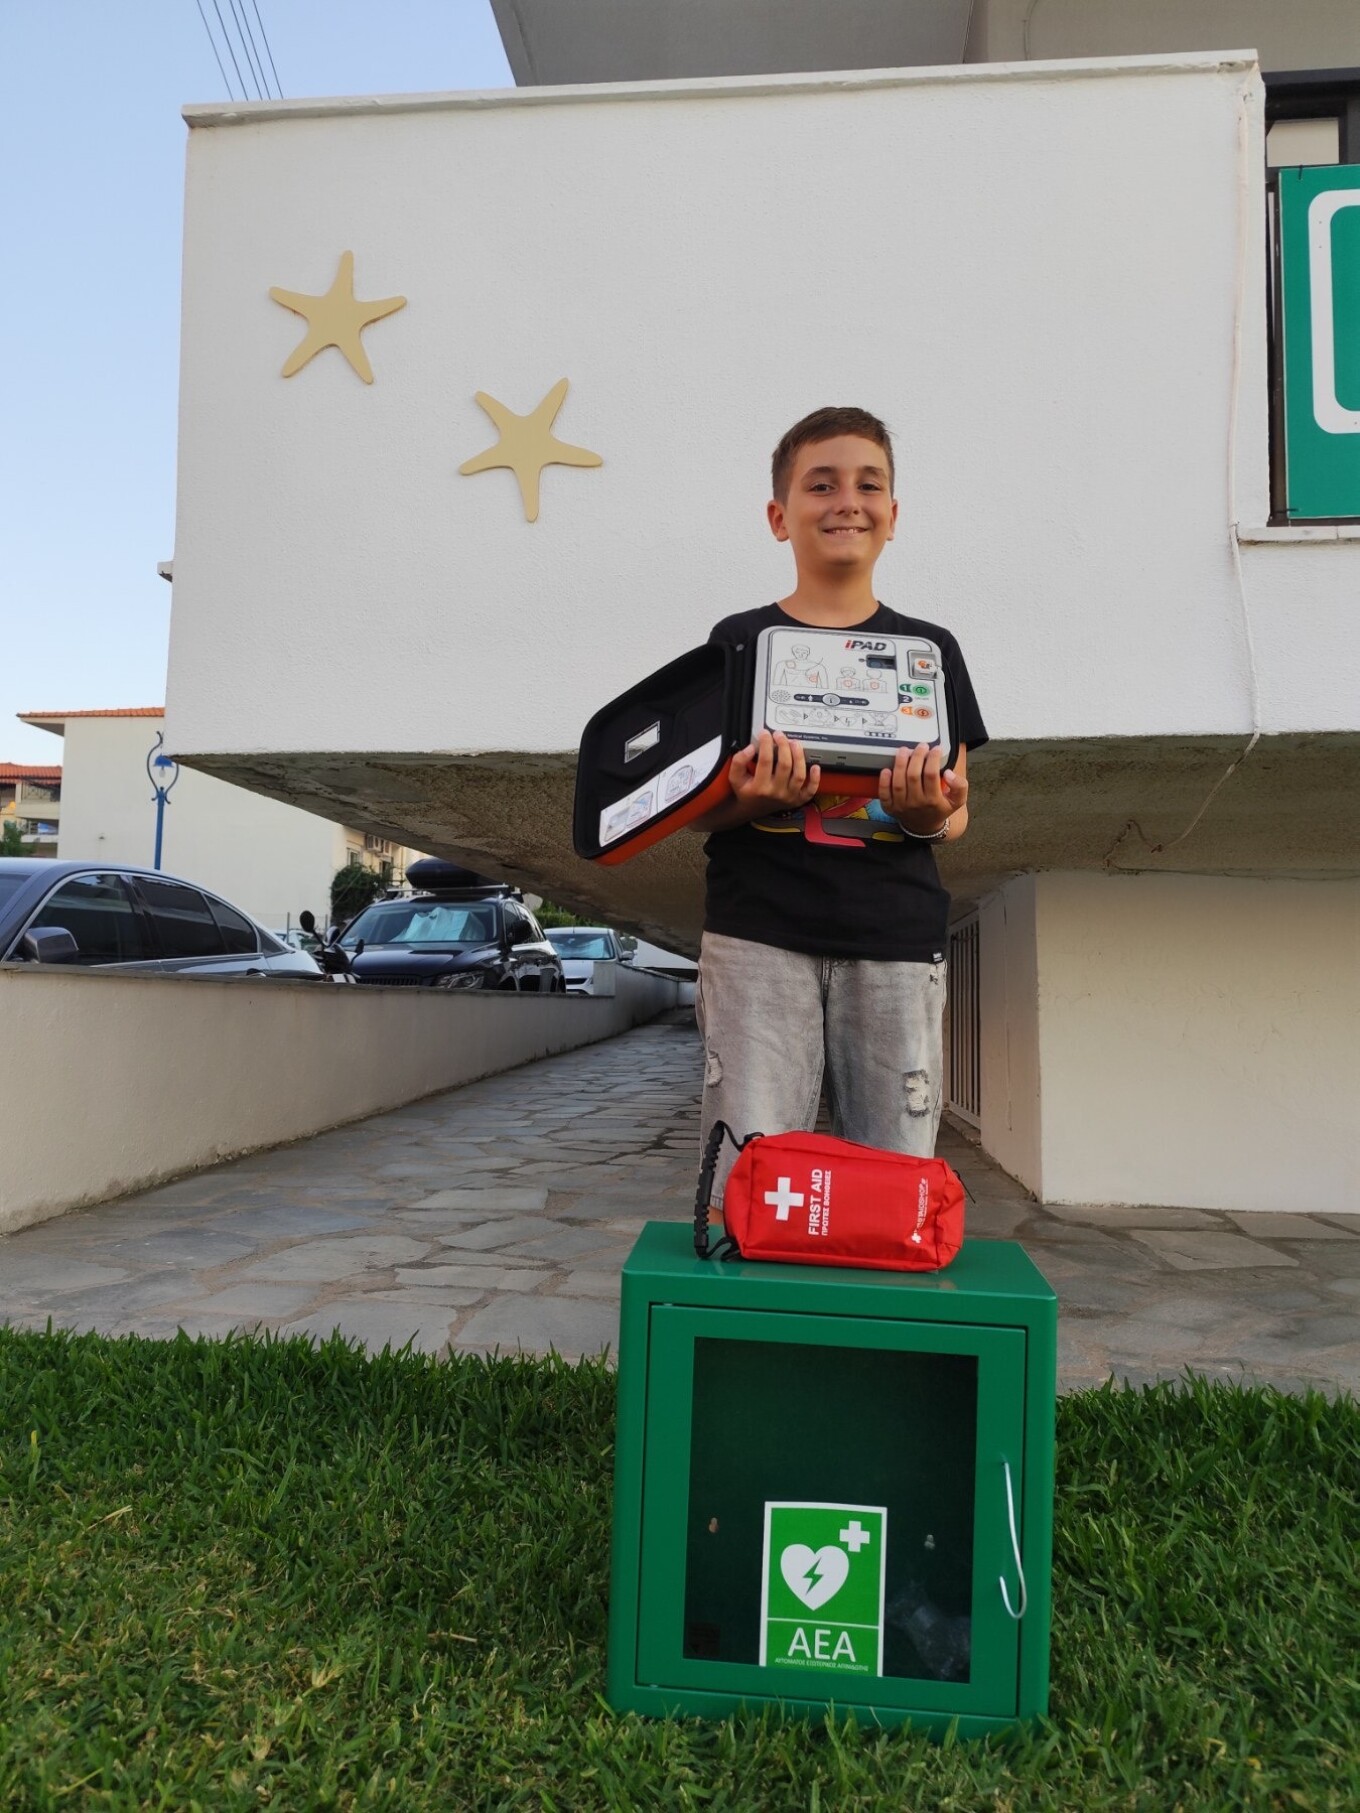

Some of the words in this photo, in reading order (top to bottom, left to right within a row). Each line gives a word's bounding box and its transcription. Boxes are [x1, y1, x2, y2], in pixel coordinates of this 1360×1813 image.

[845, 639, 886, 651] iPAD
[811, 1169, 823, 1192] AID
[823, 1170, 832, 1206] ΒΟΗΘΕΙΕΣ
[808, 1195, 821, 1236] FIRST
[821, 1207, 830, 1236] ΠΡΩΤΕΣ
